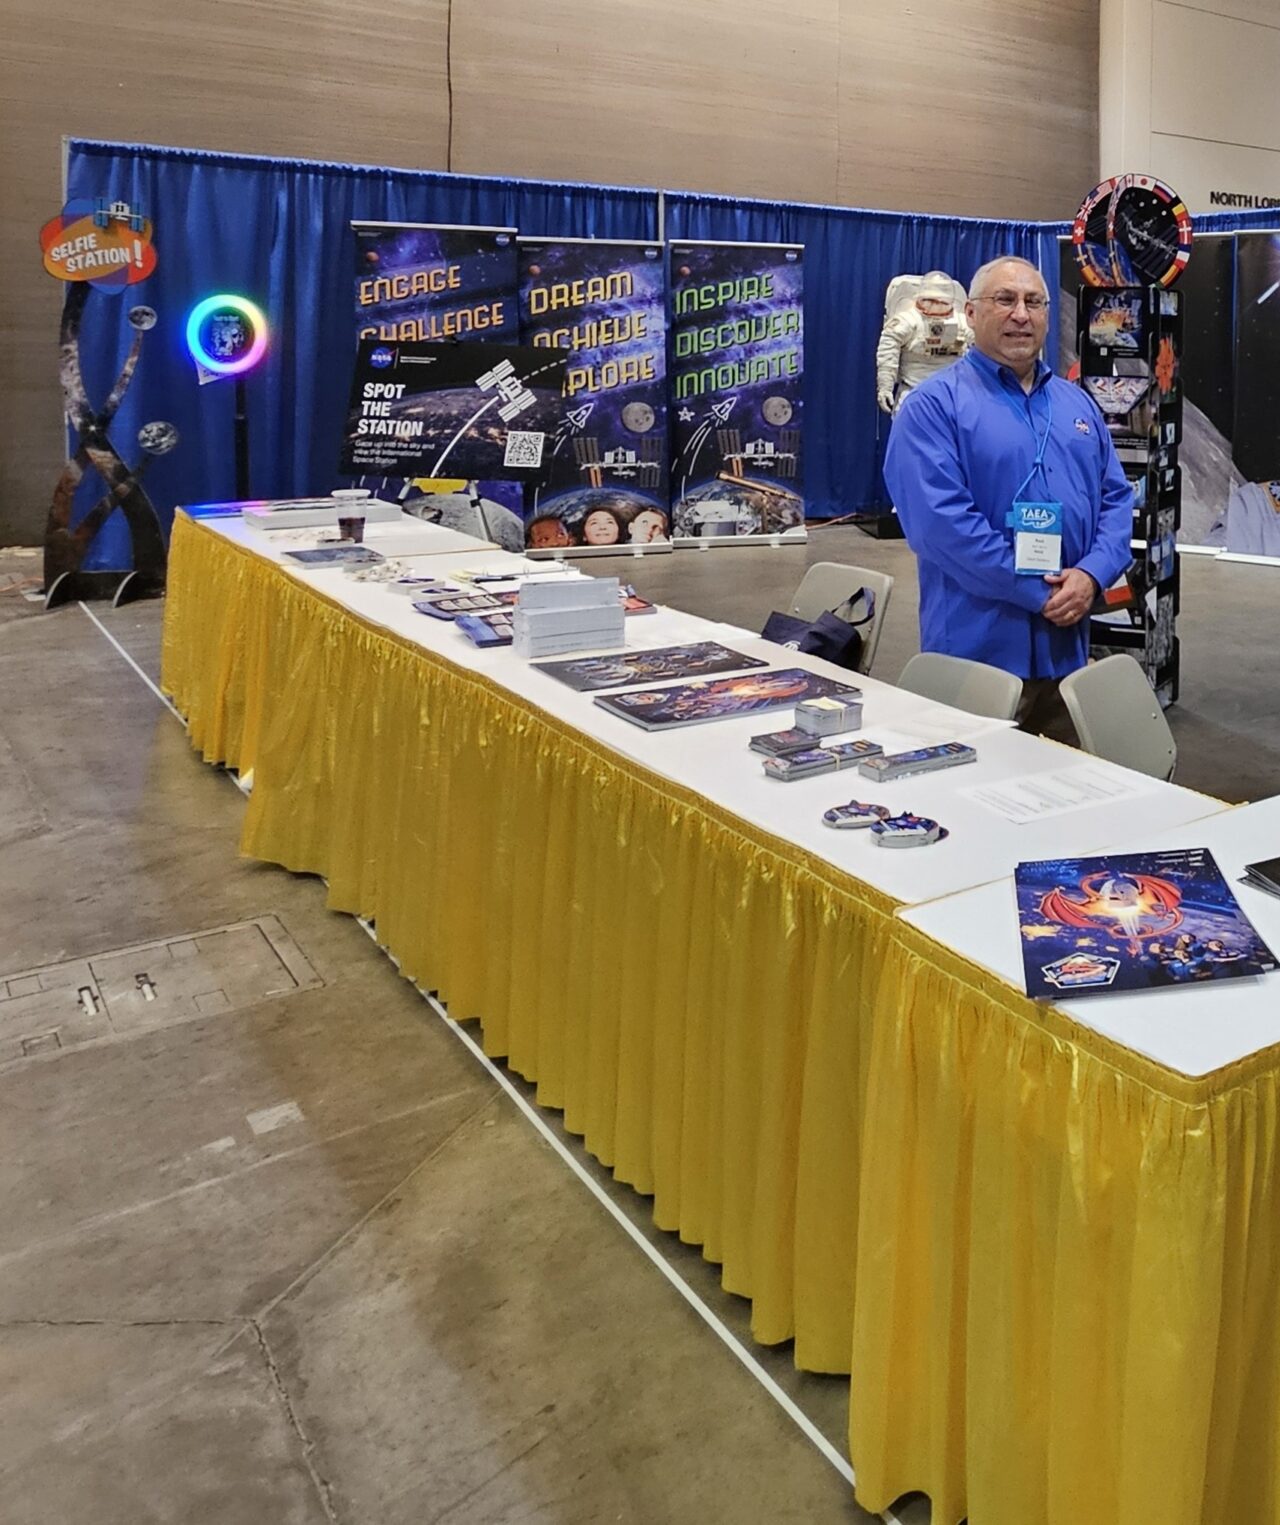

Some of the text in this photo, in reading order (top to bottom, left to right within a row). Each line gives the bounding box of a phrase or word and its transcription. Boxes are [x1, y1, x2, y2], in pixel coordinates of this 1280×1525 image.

[1210, 191, 1253, 208] NORTH
[51, 233, 97, 262] SELFIE
[359, 265, 461, 305] ENGAGE
[530, 271, 633, 315] DREAM
[675, 273, 775, 315] INSPIRE
[360, 302, 504, 342] CHALLENGE
[675, 311, 800, 357] DISCOVER
[363, 382, 406, 399] SPOT
[561, 355, 655, 398] PLORE
[675, 351, 800, 399] INNOVATE
[358, 419, 423, 437] STATION
[361, 401, 392, 417] THE
[1021, 508, 1048, 519] TAEA
